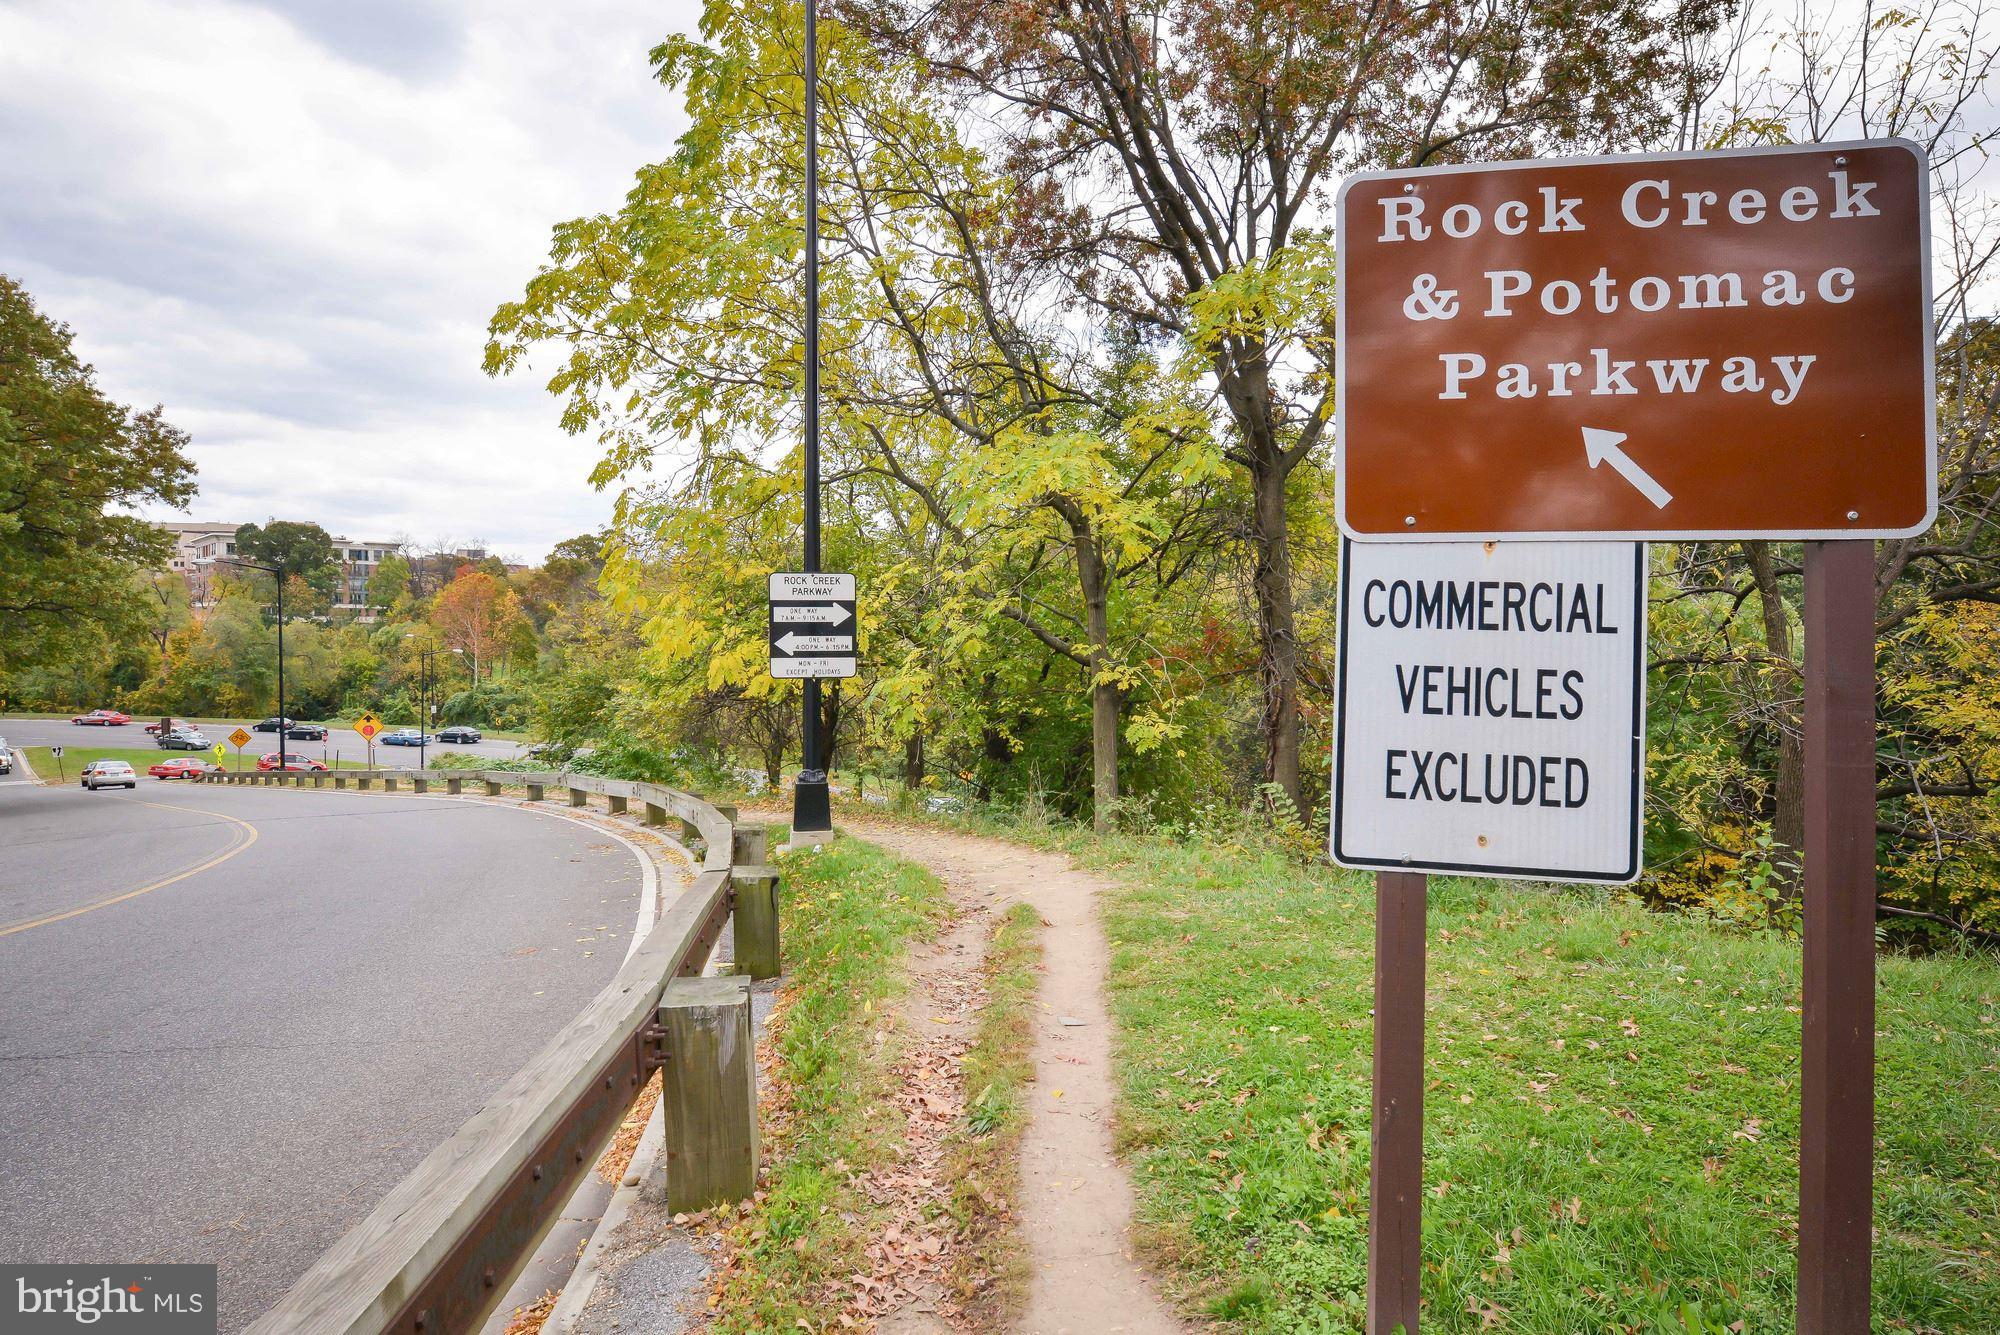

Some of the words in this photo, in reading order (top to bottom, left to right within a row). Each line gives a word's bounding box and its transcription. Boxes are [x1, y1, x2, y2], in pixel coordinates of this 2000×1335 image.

[1376, 186, 1585, 243] Rock
[1621, 170, 1881, 229] Creek
[1402, 272, 1460, 321] &
[1483, 266, 1856, 317] Potomac
[1438, 348, 1816, 406] Parkway
[784, 577, 807, 585] ROCK
[812, 577, 841, 585] CREEK
[792, 587, 833, 596] PARKWAY
[1363, 579, 1618, 634] COMMERCIAL
[1396, 664, 1584, 720] VEHICLES
[1385, 749, 1589, 809] EXCLUDED
